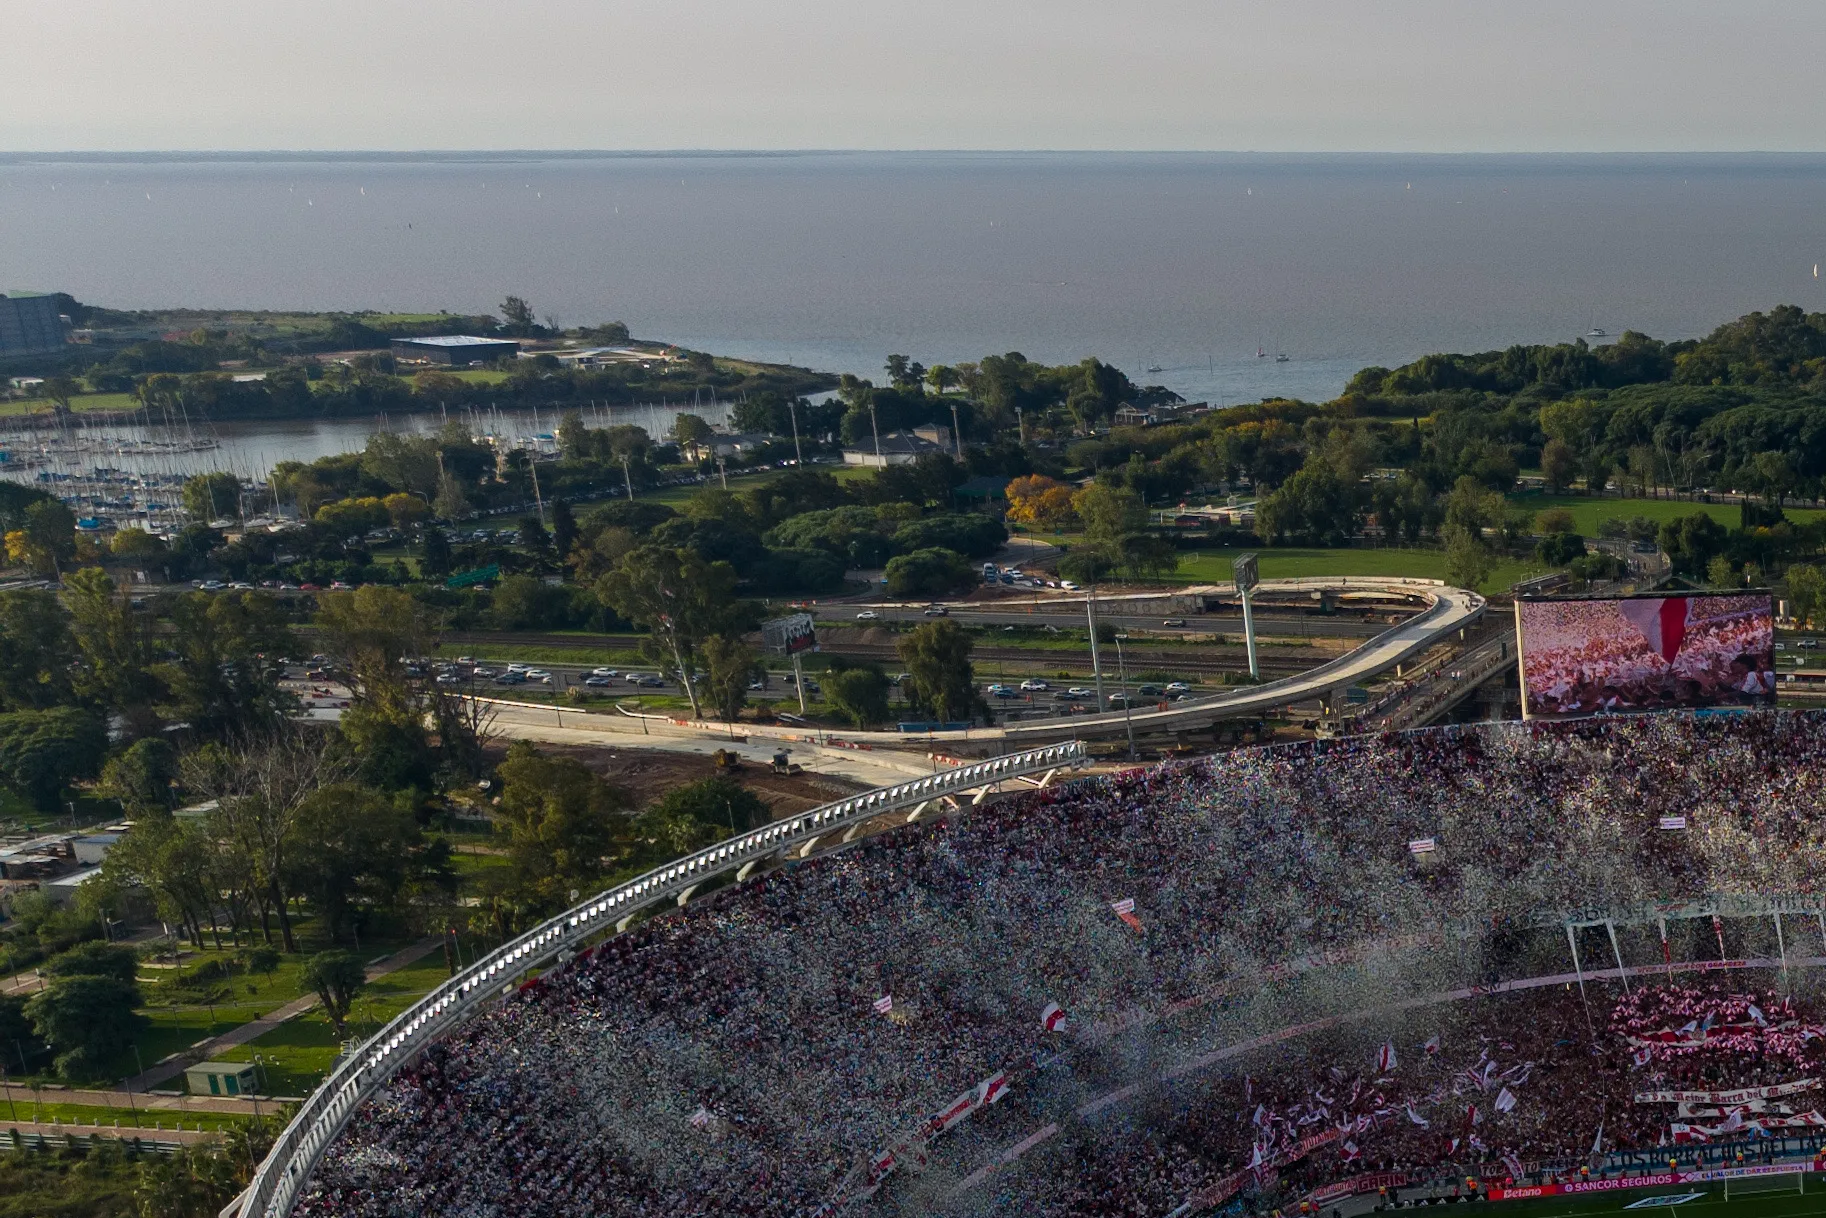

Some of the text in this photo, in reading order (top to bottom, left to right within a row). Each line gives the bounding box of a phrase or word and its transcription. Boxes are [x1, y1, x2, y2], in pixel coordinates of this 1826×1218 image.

[1609, 1150, 1646, 1169] LOS
[1649, 1142, 1756, 1165] BORRACHOS
[1760, 1139, 1788, 1155] DEL
[1575, 1174, 1672, 1192] SANCOR SEGUROS
[1503, 1186, 1542, 1199] Betano
